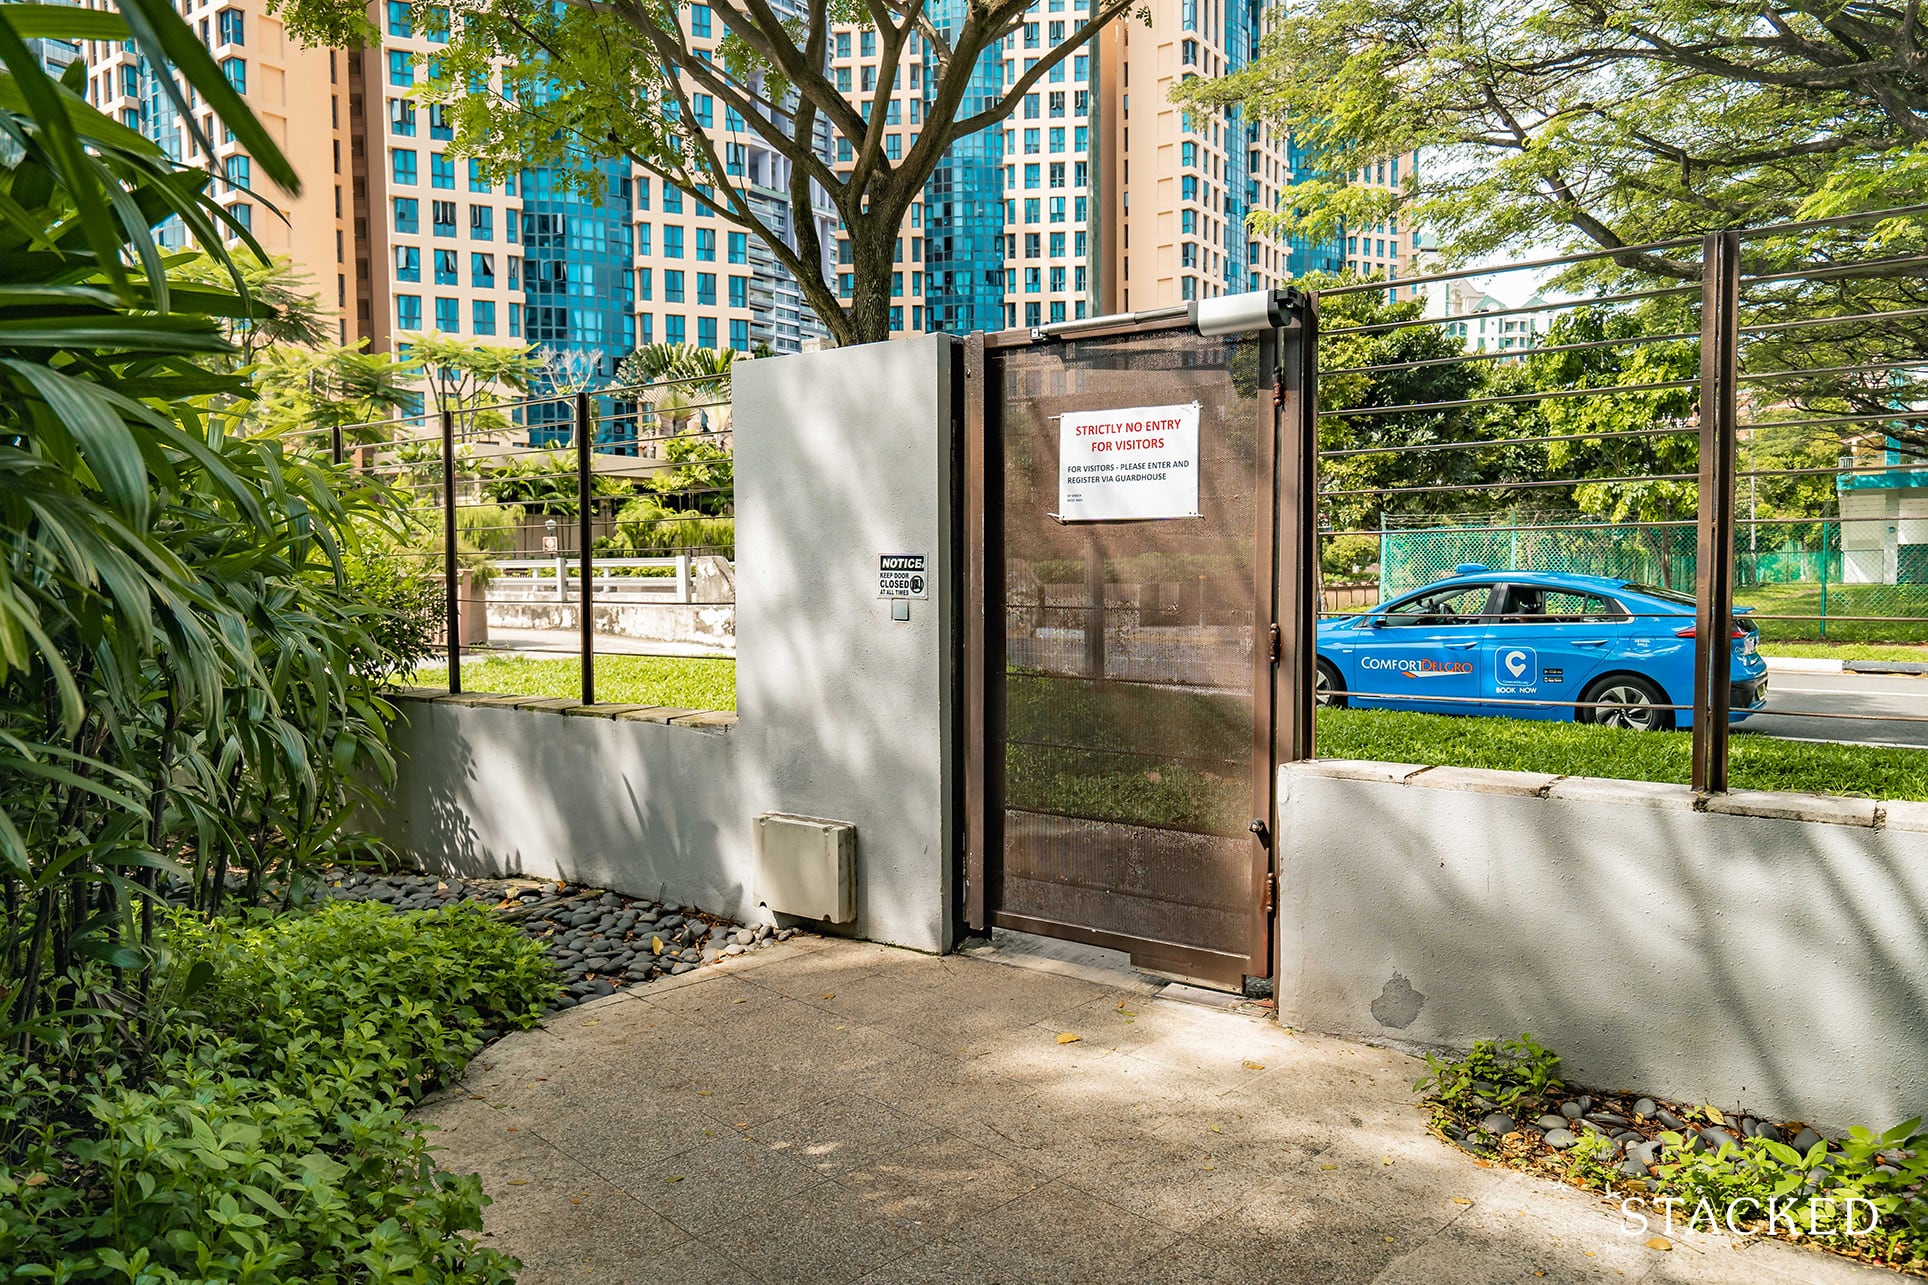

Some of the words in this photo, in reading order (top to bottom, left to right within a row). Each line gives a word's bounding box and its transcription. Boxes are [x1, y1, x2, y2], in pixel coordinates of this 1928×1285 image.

[1076, 423, 1122, 436] STRICTLY
[1126, 422, 1142, 432] NO
[1146, 419, 1181, 431] ENTRY
[1091, 442, 1112, 452] FOR
[1116, 438, 1165, 451] VISITORS
[1083, 464, 1114, 472] VISITORS
[1120, 462, 1145, 471] PLEASE
[1067, 476, 1100, 484] REGISTER
[1115, 473, 1166, 482] GUARDHOUSE
[882, 558, 922, 569] NOTICE
[880, 580, 909, 588] CLOSED
